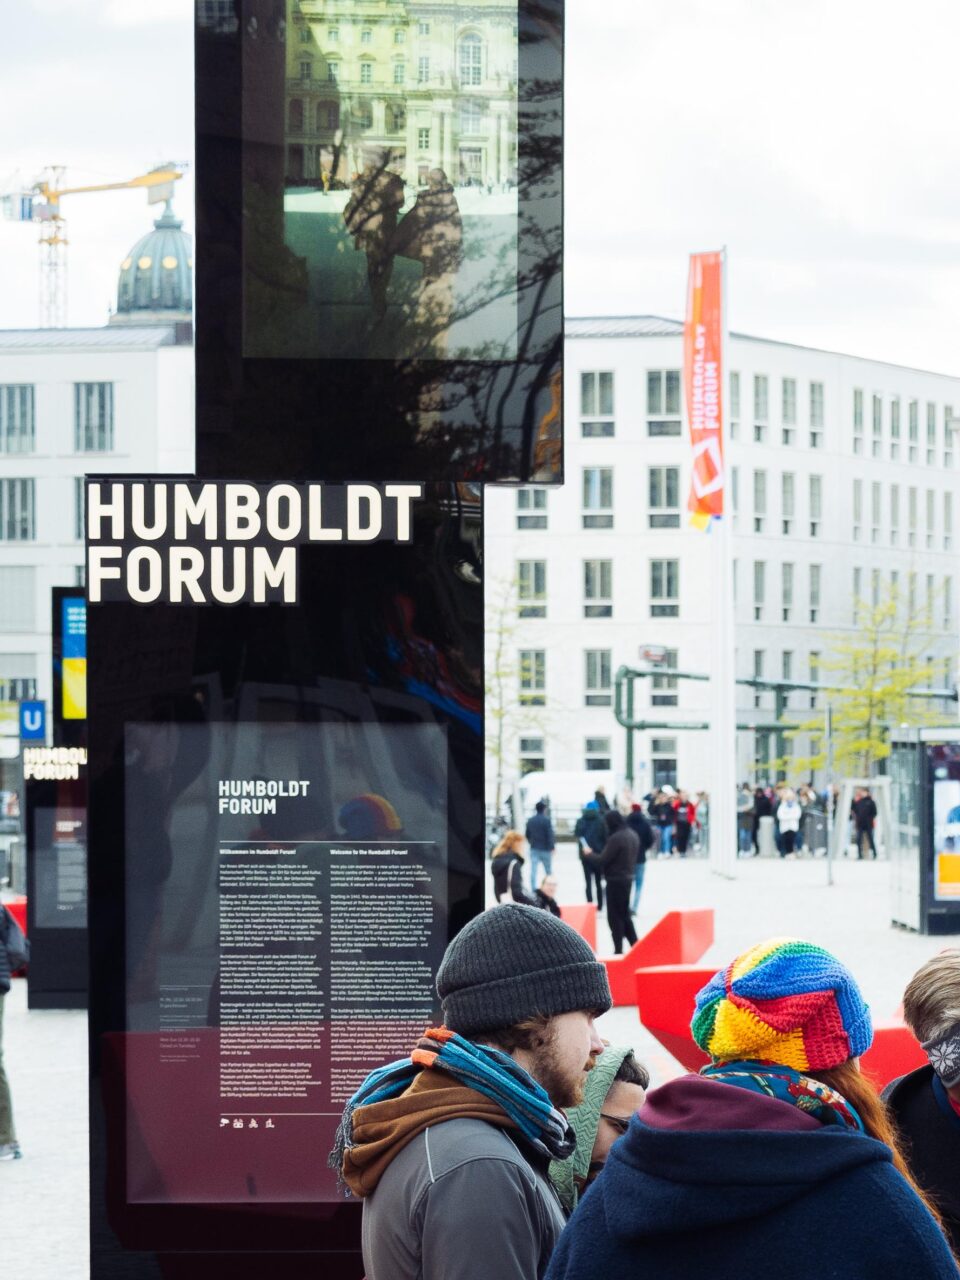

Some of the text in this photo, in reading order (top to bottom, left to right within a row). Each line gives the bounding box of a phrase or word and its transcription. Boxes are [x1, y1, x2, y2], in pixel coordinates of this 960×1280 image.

[704, 361, 719, 430] FORUM
[88, 483, 422, 541] HUMBOLDT
[88, 545, 296, 603] FORUM
[24, 710, 42, 731] U
[24, 764, 79, 780] FORUM
[218, 780, 310, 797] HUMBOLDT
[218, 798, 277, 815] FORUM
